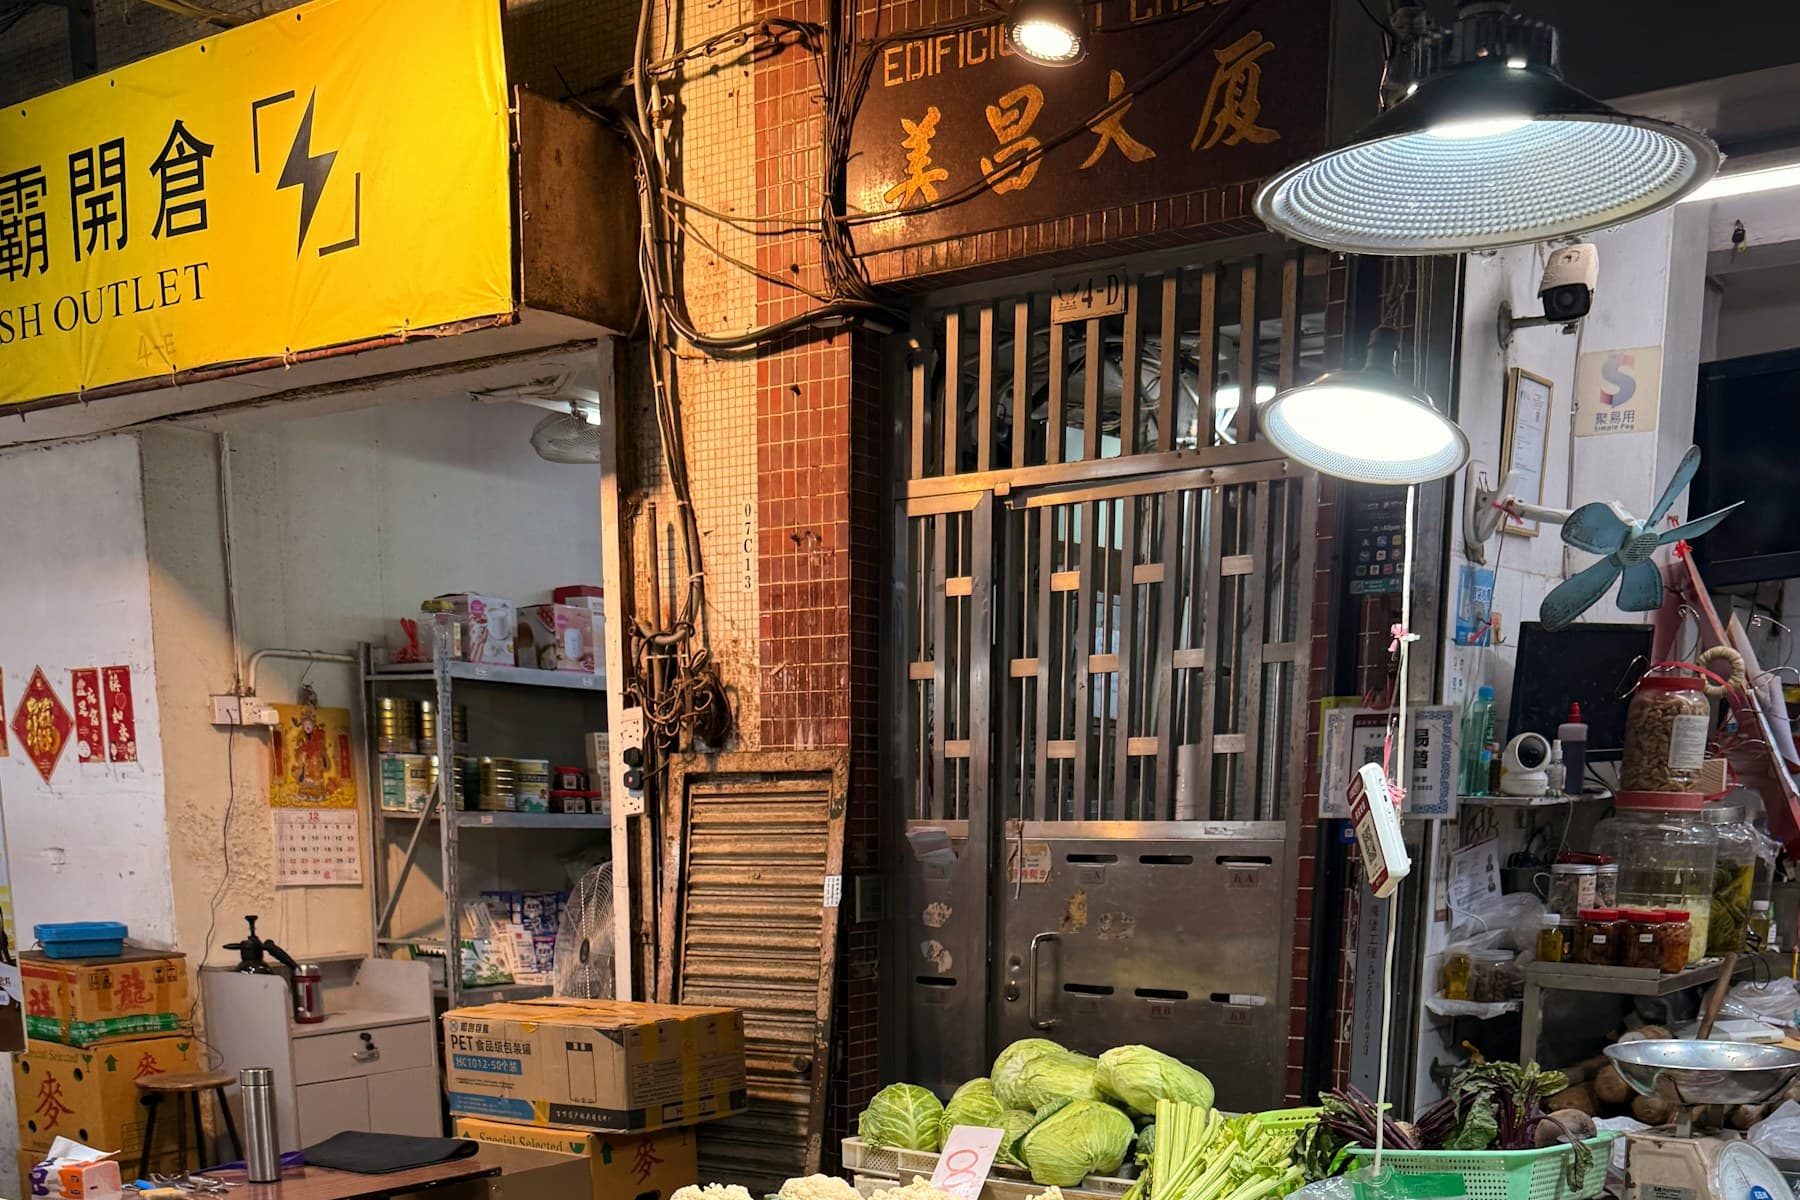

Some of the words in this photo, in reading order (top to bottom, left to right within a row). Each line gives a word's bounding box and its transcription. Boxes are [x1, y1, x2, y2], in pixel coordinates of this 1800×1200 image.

[54, 262, 209, 332] OUTLET
[743, 503, 753, 590] 07C13
[451, 1034, 473, 1051] PET
